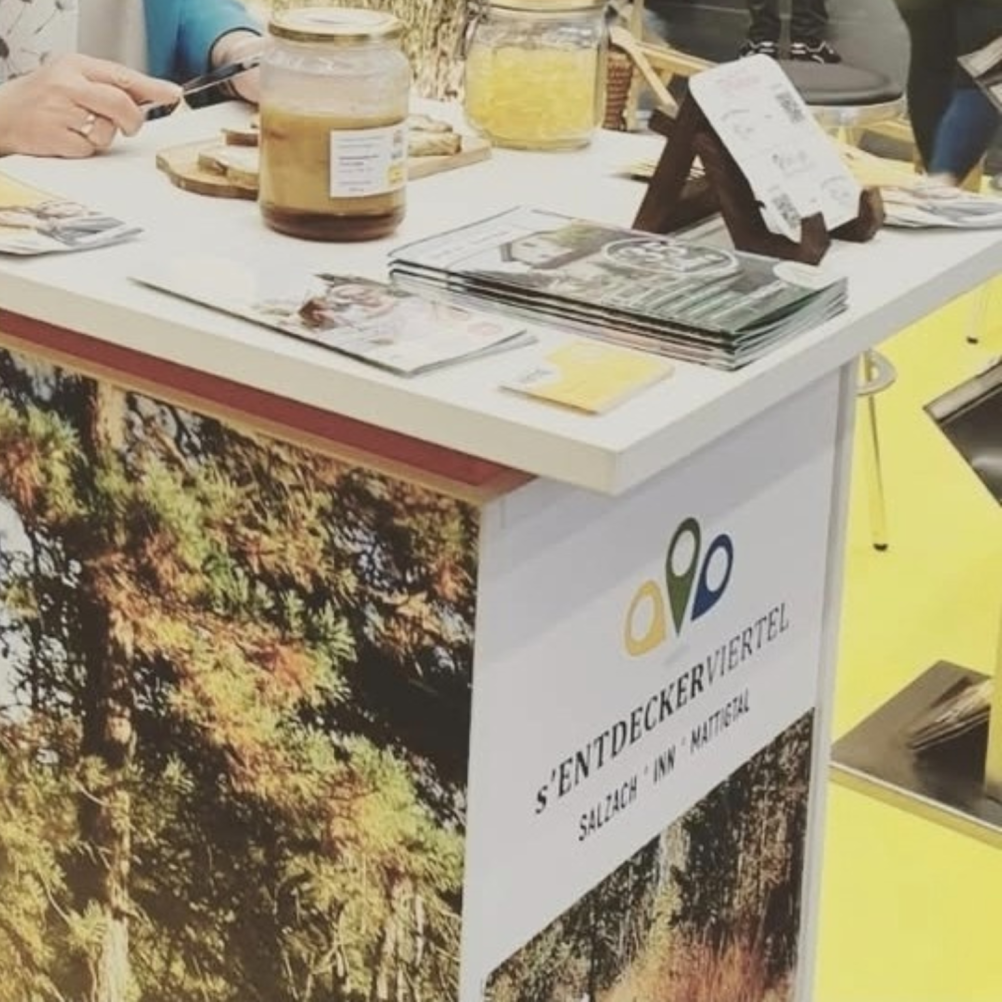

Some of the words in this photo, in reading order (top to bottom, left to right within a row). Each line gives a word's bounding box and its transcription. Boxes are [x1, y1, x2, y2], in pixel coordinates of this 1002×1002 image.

[578, 775, 638, 842] SALZACH
[653, 745, 676, 785] INN
[690, 688, 750, 755] MATTIGTAL
